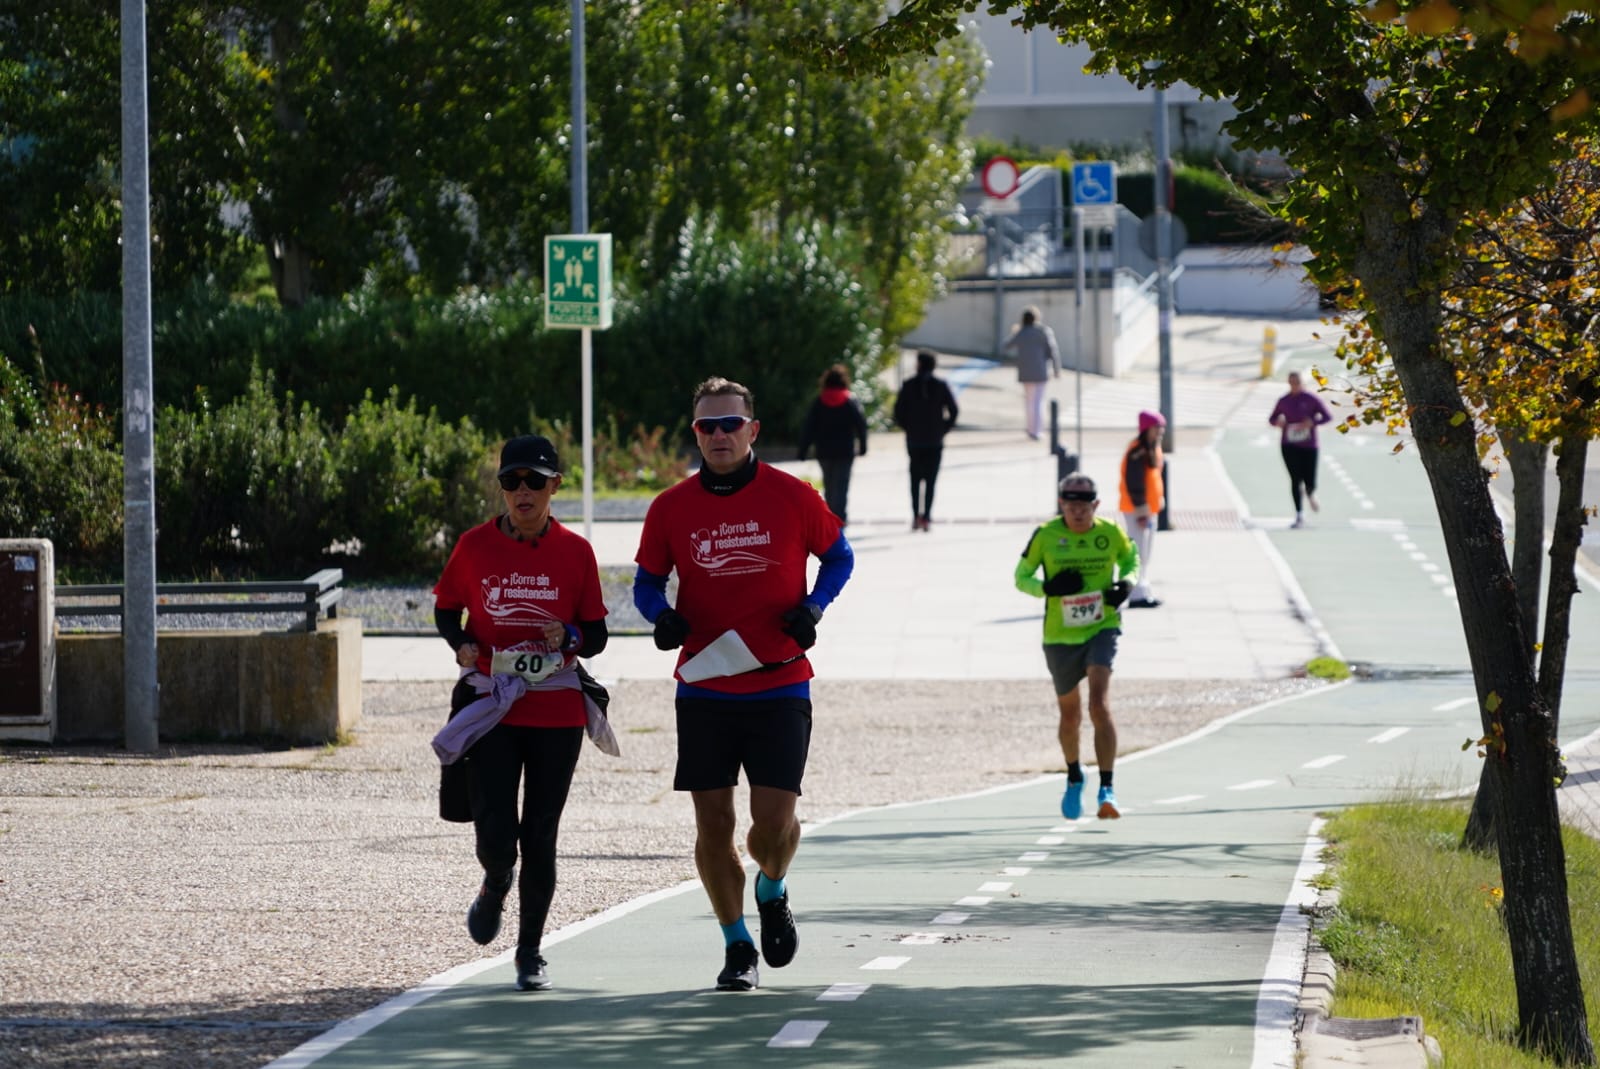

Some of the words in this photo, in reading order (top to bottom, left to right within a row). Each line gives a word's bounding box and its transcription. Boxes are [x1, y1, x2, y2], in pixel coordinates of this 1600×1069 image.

[720, 522, 745, 537] ¡Corre
[745, 520, 759, 532] sin
[715, 531, 771, 550] resistencias!
[510, 572, 535, 586] ¡Corre
[536, 573, 549, 586] sin
[504, 586, 559, 600] resistencias!
[1071, 603, 1096, 619] 299
[514, 654, 543, 674] 60
